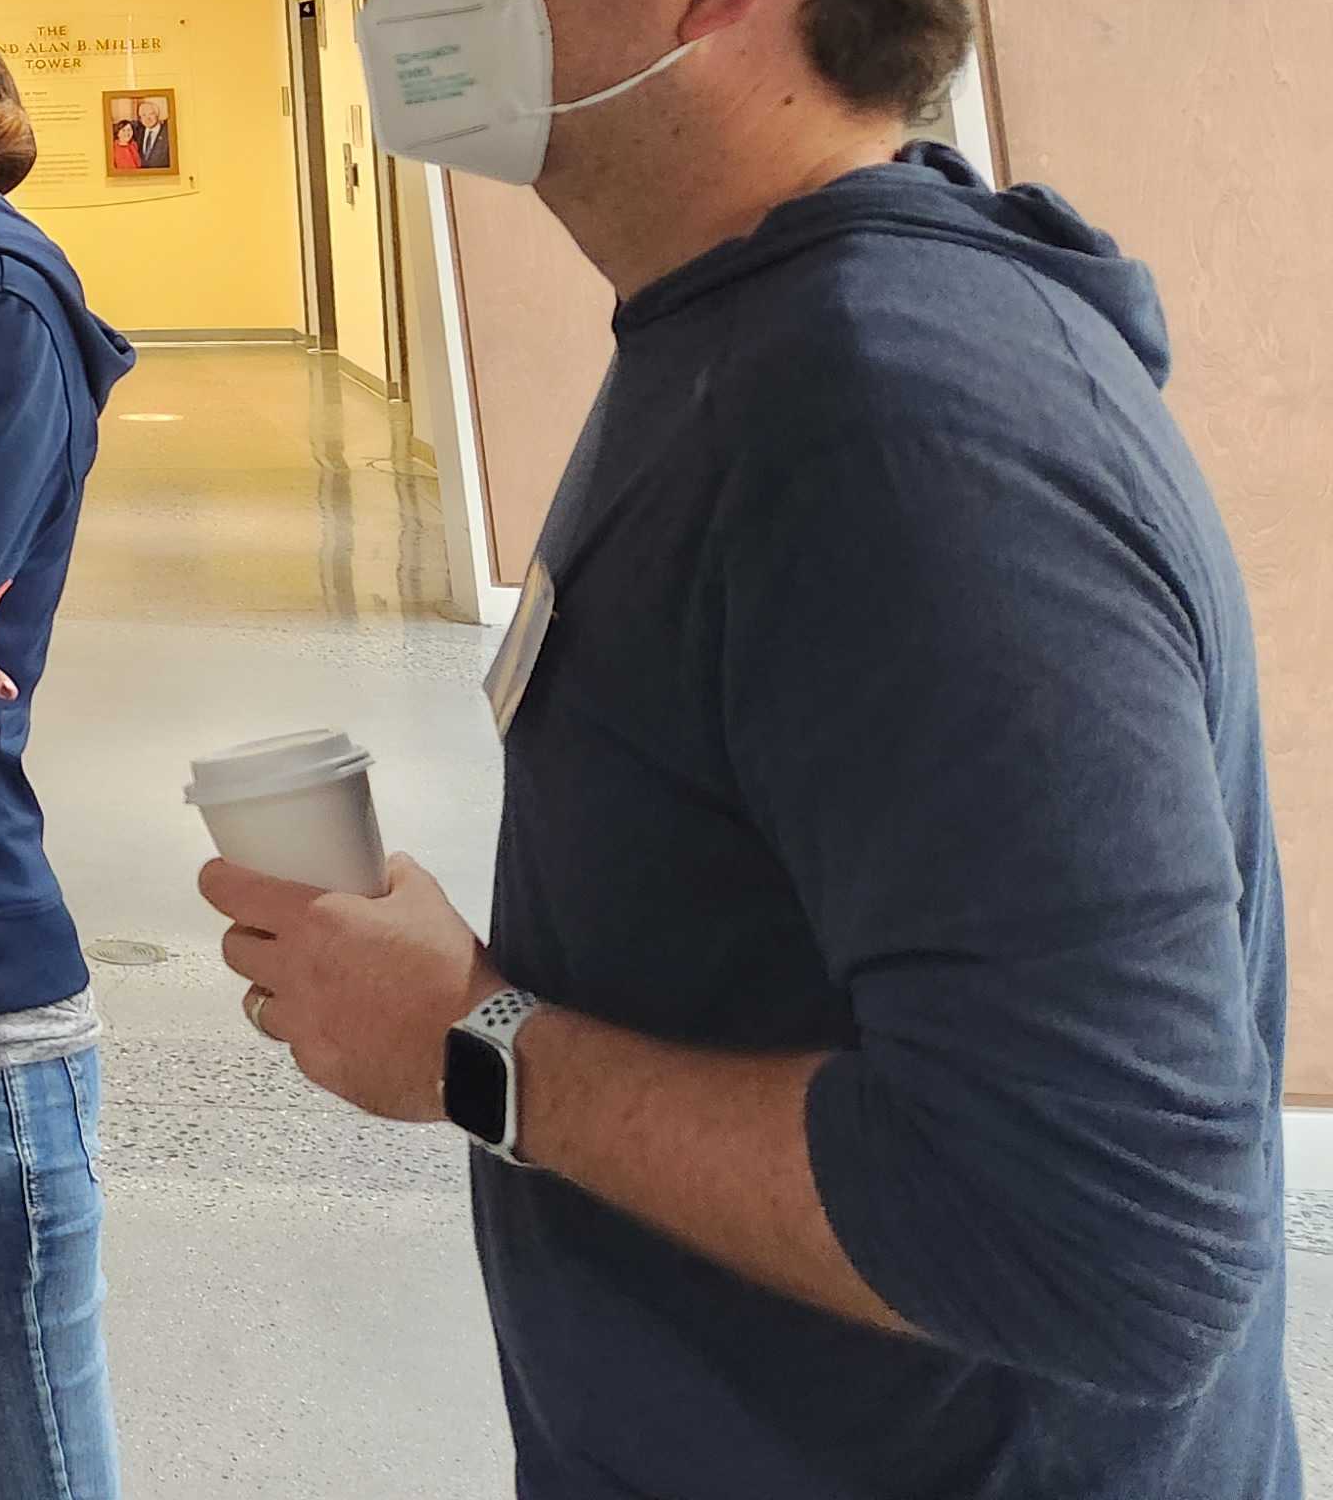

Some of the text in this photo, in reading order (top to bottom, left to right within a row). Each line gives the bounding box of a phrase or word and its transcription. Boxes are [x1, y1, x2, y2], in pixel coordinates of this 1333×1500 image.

[37, 25, 68, 36] THE
[26, 41, 71, 54] ALAN
[77, 39, 92, 51] B.
[96, 37, 162, 51] MILLER
[25, 58, 83, 70] TOWER
